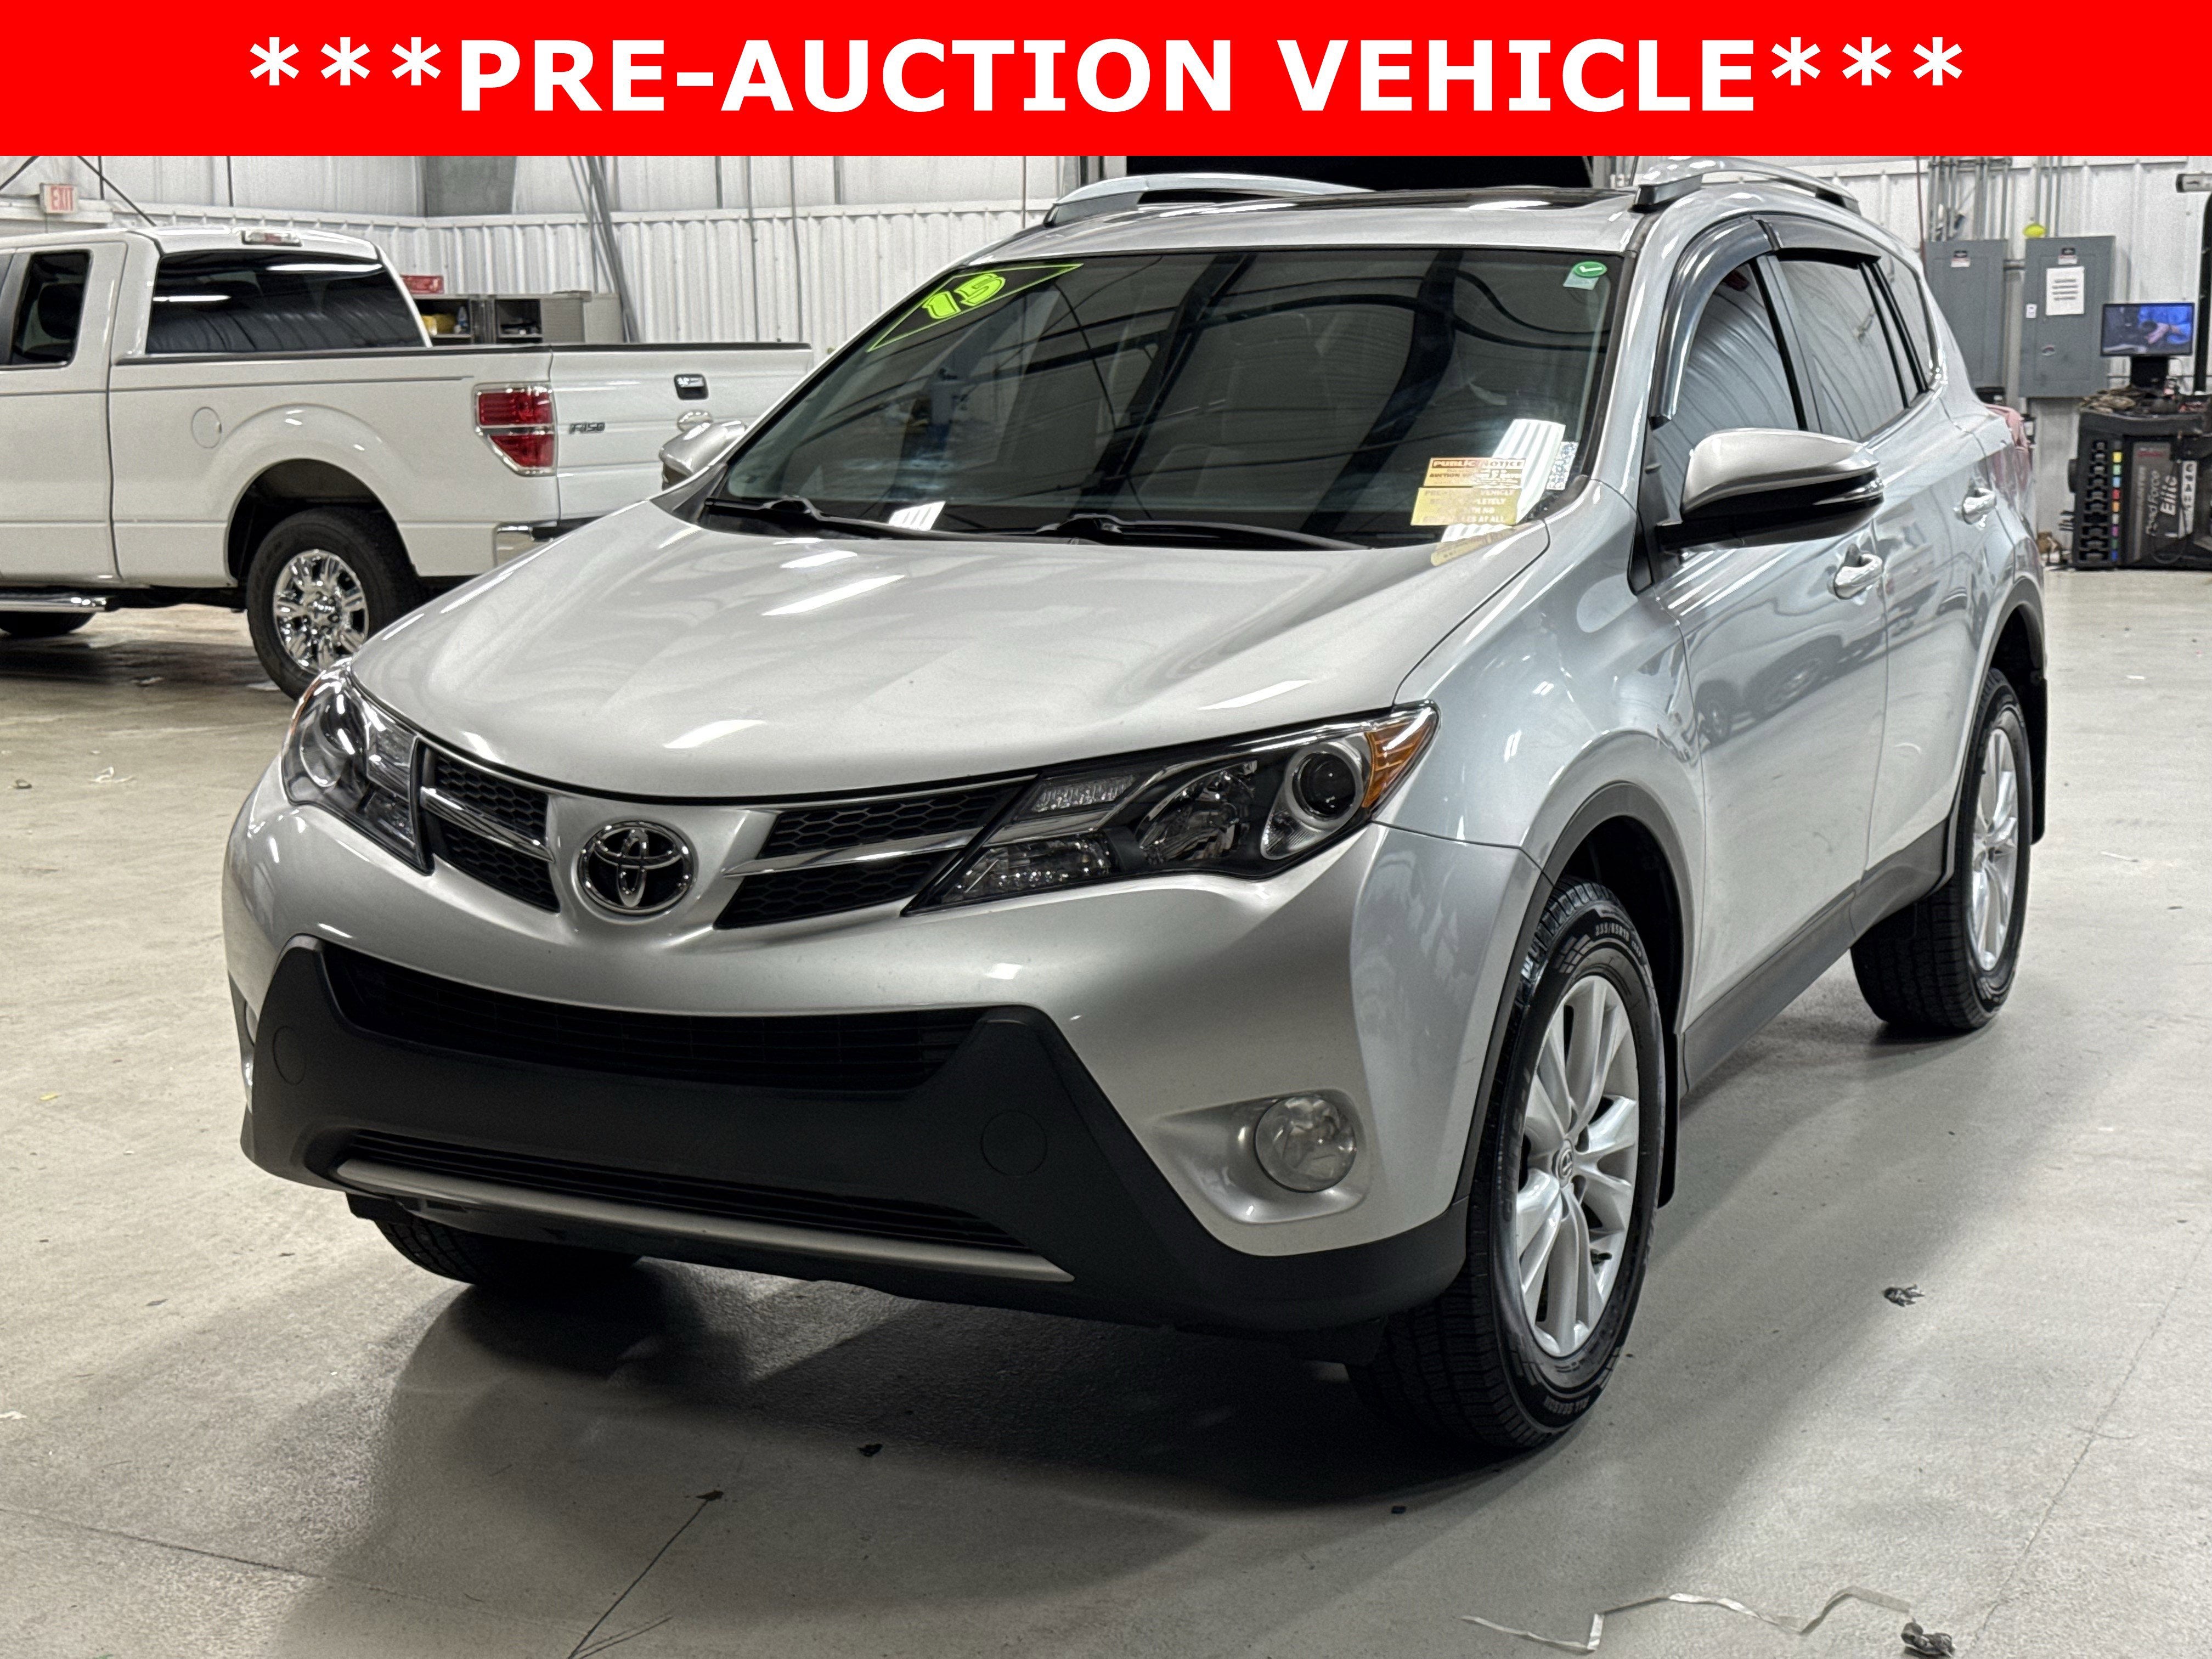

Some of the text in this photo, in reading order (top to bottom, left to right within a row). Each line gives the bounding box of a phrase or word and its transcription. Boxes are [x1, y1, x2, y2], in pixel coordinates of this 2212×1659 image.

[51, 185, 74, 211] EXIT
[922, 272, 1006, 320] 15
[2147, 470, 2160, 504] Force
